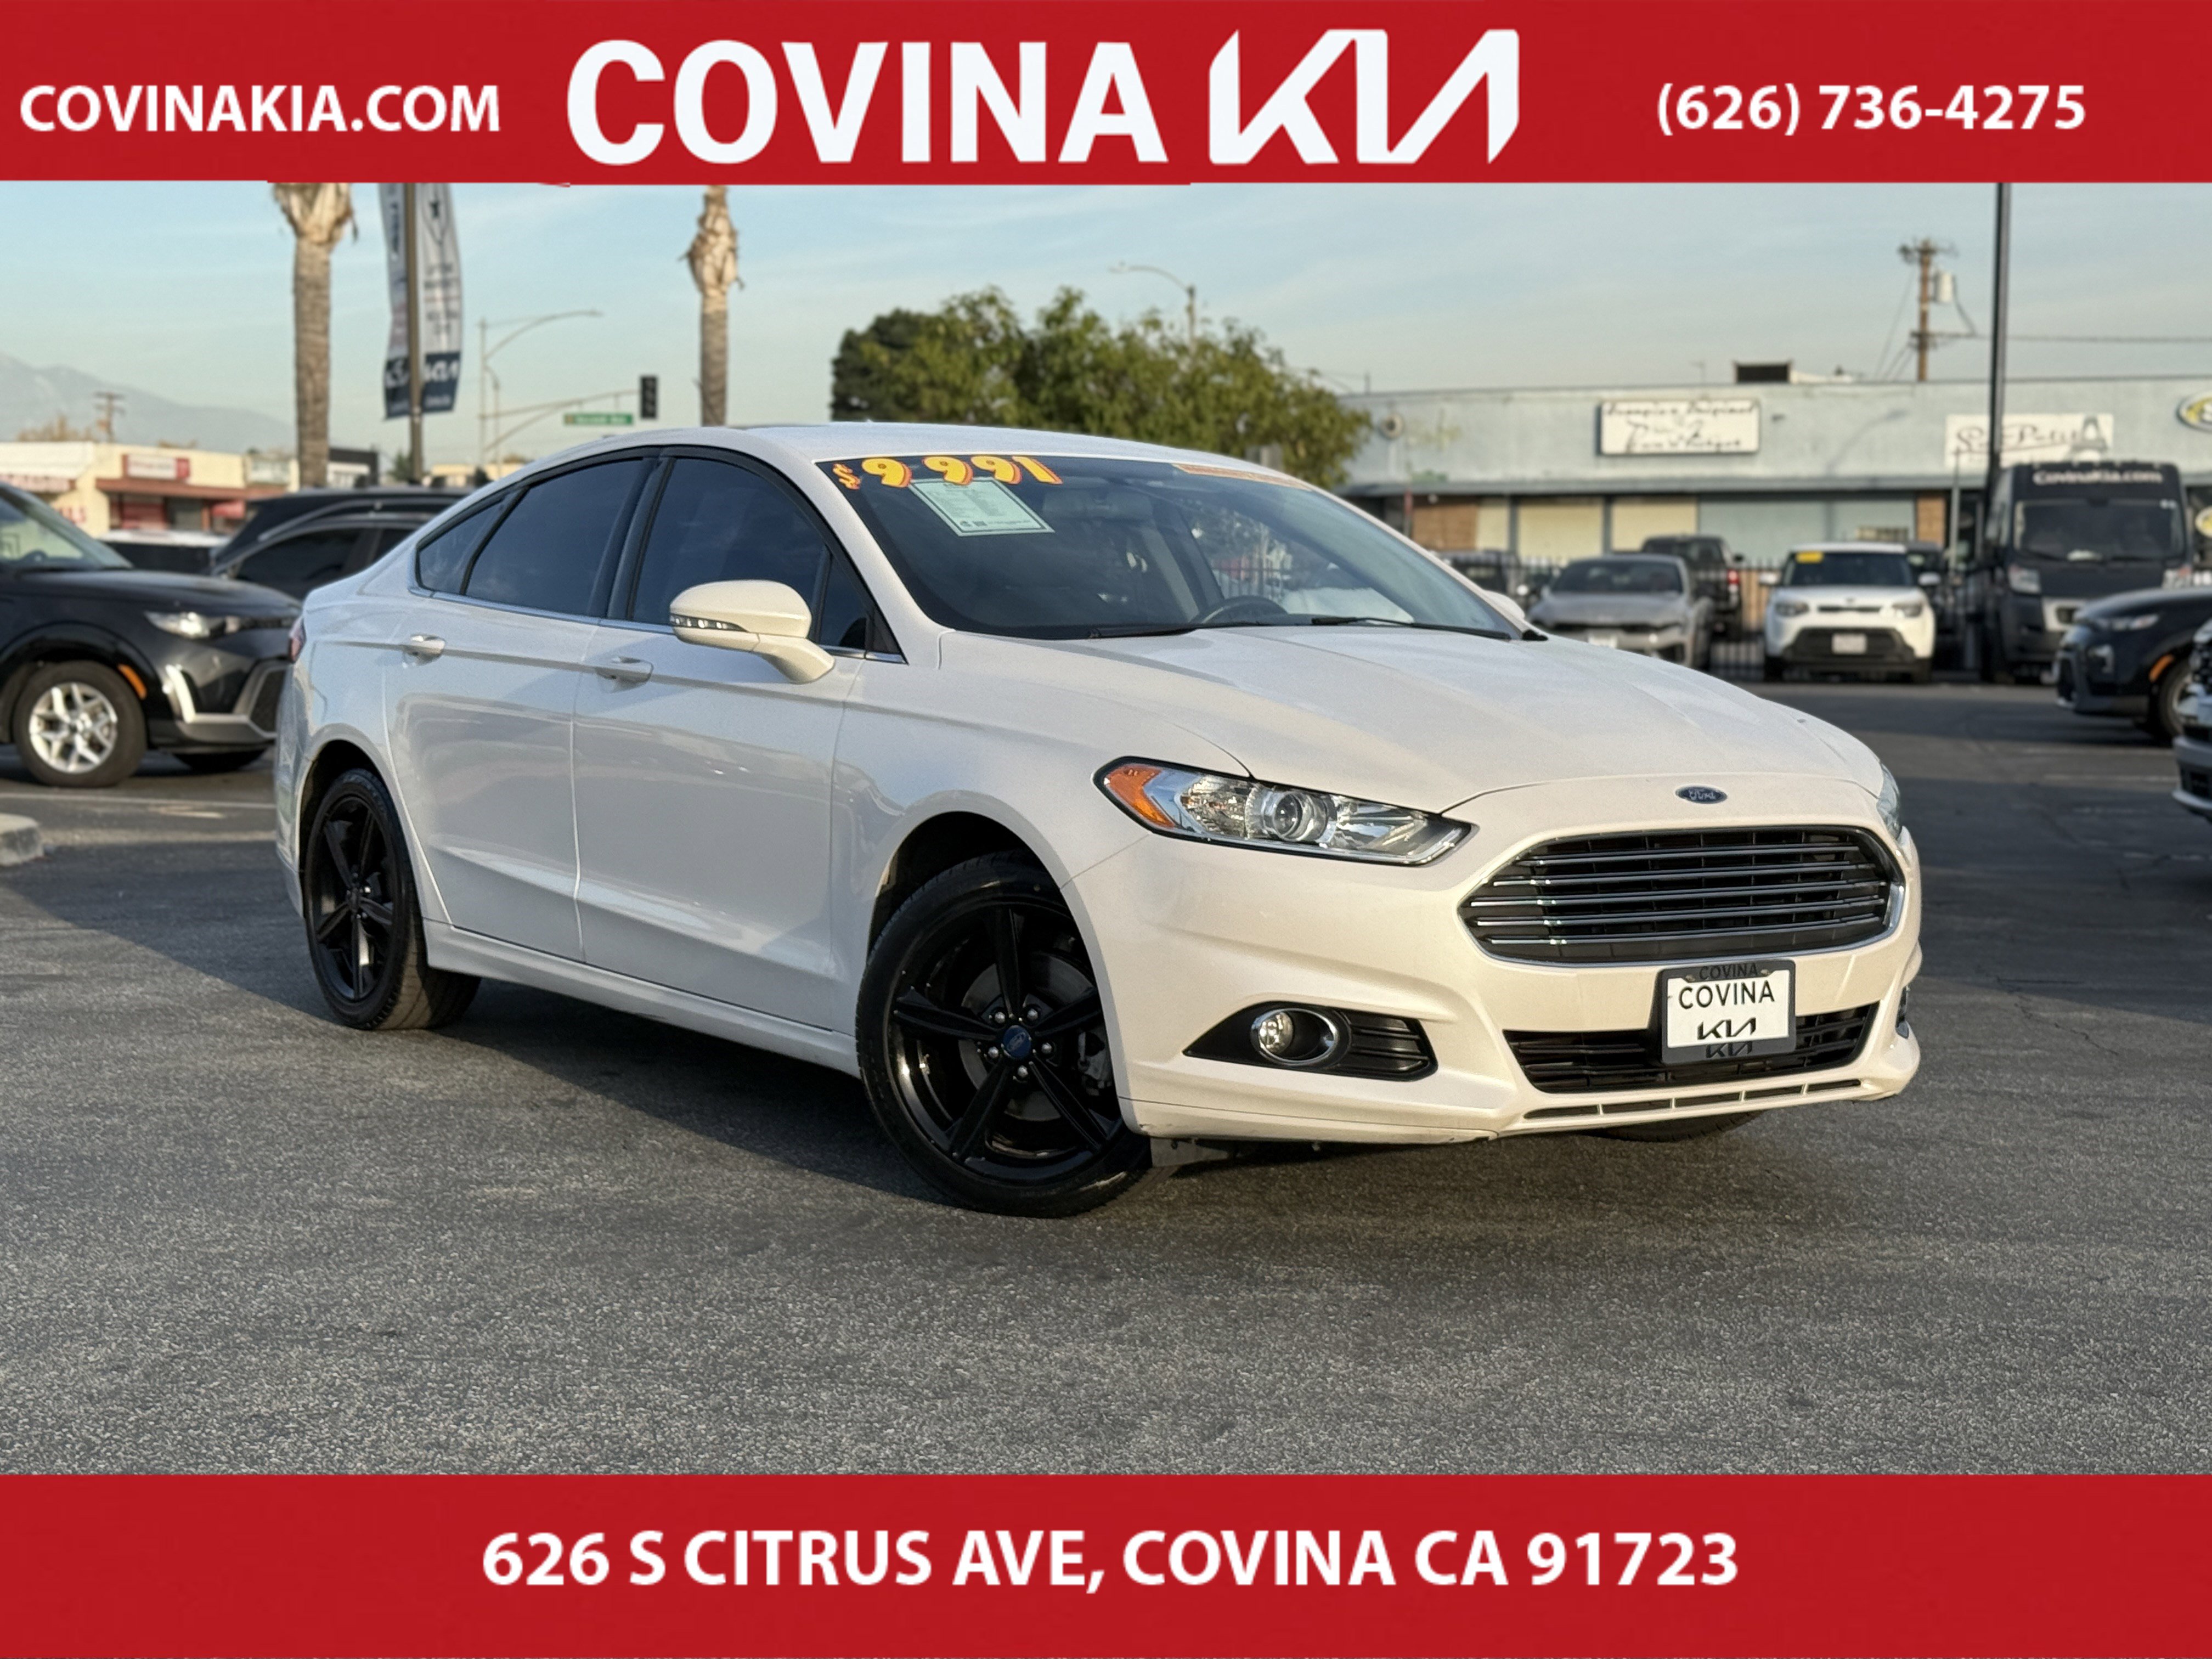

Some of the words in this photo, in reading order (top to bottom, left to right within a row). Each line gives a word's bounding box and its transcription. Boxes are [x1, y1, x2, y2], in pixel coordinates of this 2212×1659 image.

[1688, 788, 1716, 800] Ford
[1699, 962, 1759, 980] COVINA
[1678, 980, 1775, 1010] COVINA
